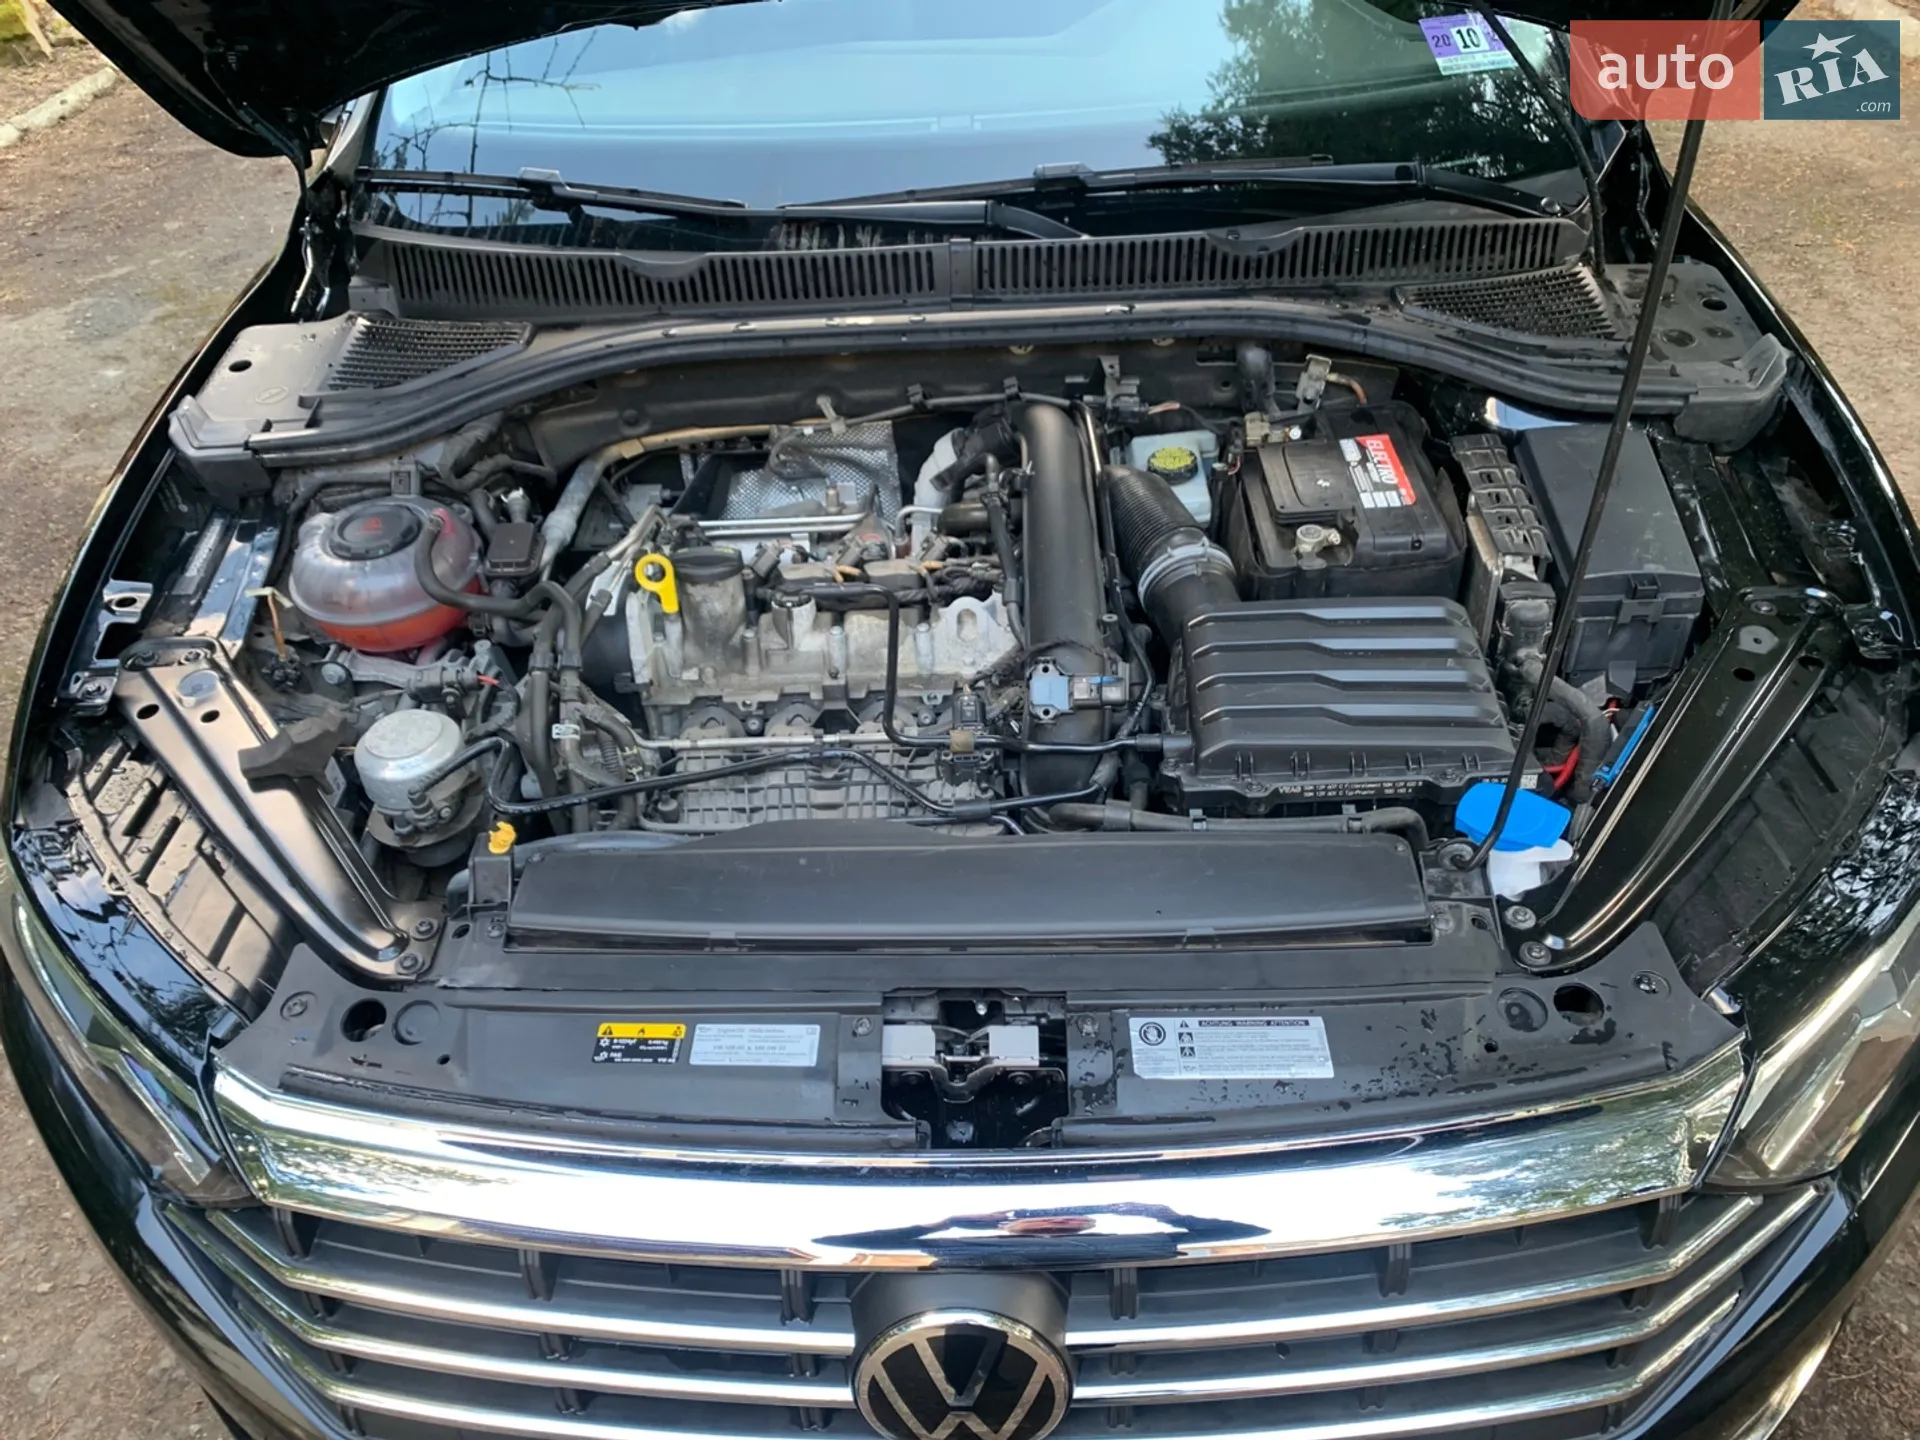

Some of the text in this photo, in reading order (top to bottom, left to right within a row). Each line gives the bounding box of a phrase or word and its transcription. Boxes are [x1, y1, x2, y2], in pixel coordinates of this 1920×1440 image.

[1431, 34, 1452, 48] 20
[1456, 28, 1481, 49] 10
[1365, 439, 1399, 485] ELECTRO
